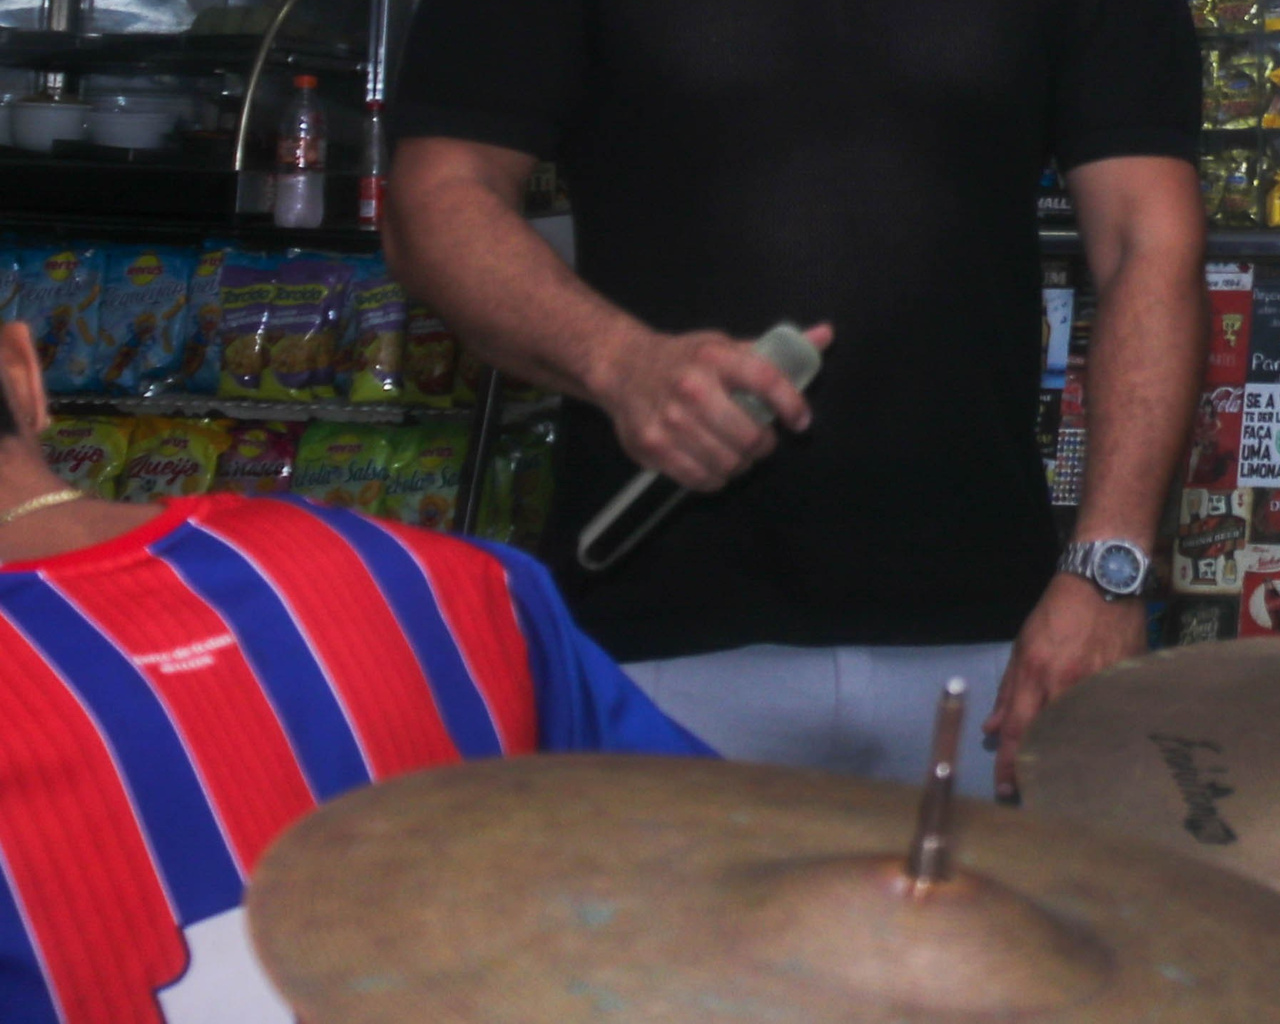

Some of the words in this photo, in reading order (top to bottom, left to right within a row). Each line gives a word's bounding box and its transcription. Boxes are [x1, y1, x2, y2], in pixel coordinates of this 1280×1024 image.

[1246, 393, 1261, 409] SE
[1265, 394, 1275, 410] A
[1244, 412, 1255, 423] TE
[1257, 412, 1273, 423] DER
[1243, 426, 1272, 443] FAÇA
[1241, 444, 1271, 462] UMA
